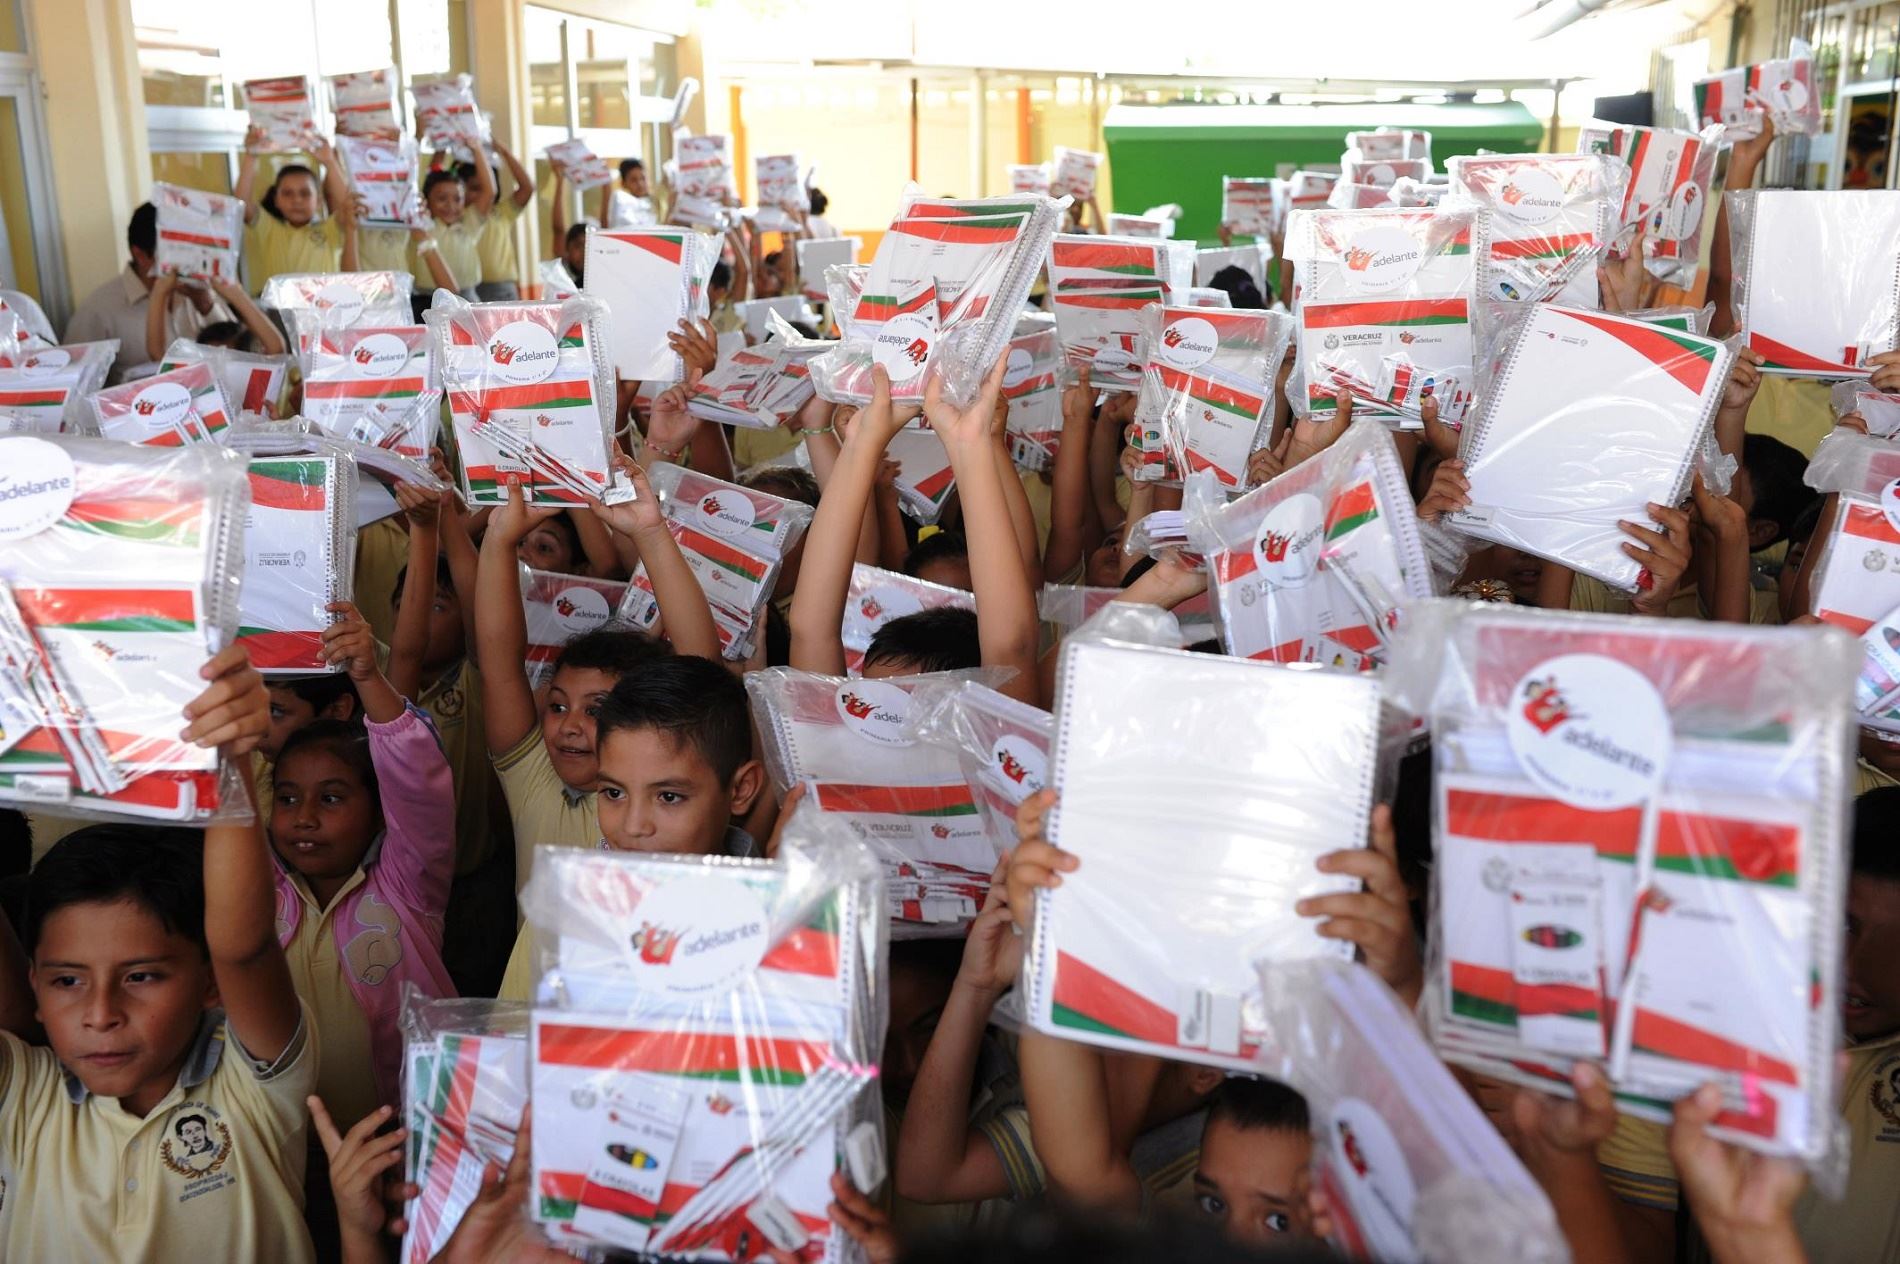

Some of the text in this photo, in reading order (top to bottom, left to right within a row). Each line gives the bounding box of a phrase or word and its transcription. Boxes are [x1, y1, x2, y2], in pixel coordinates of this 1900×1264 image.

[1522, 198, 1561, 208] adelante
[1373, 251, 1418, 268] adelante
[878, 335, 911, 345] adelante
[1342, 333, 1382, 341] VERACRUZ
[1180, 342, 1213, 353] adelante
[373, 352, 406, 364] adelante
[516, 350, 556, 362] adelante
[156, 397, 189, 412] adelante
[0, 476, 71, 500] adelante
[717, 512, 750, 526] adelante
[575, 611, 607, 620] adelante
[874, 712, 903, 724] adela
[1561, 729, 1656, 781] adelante
[683, 921, 761, 957] adelante
